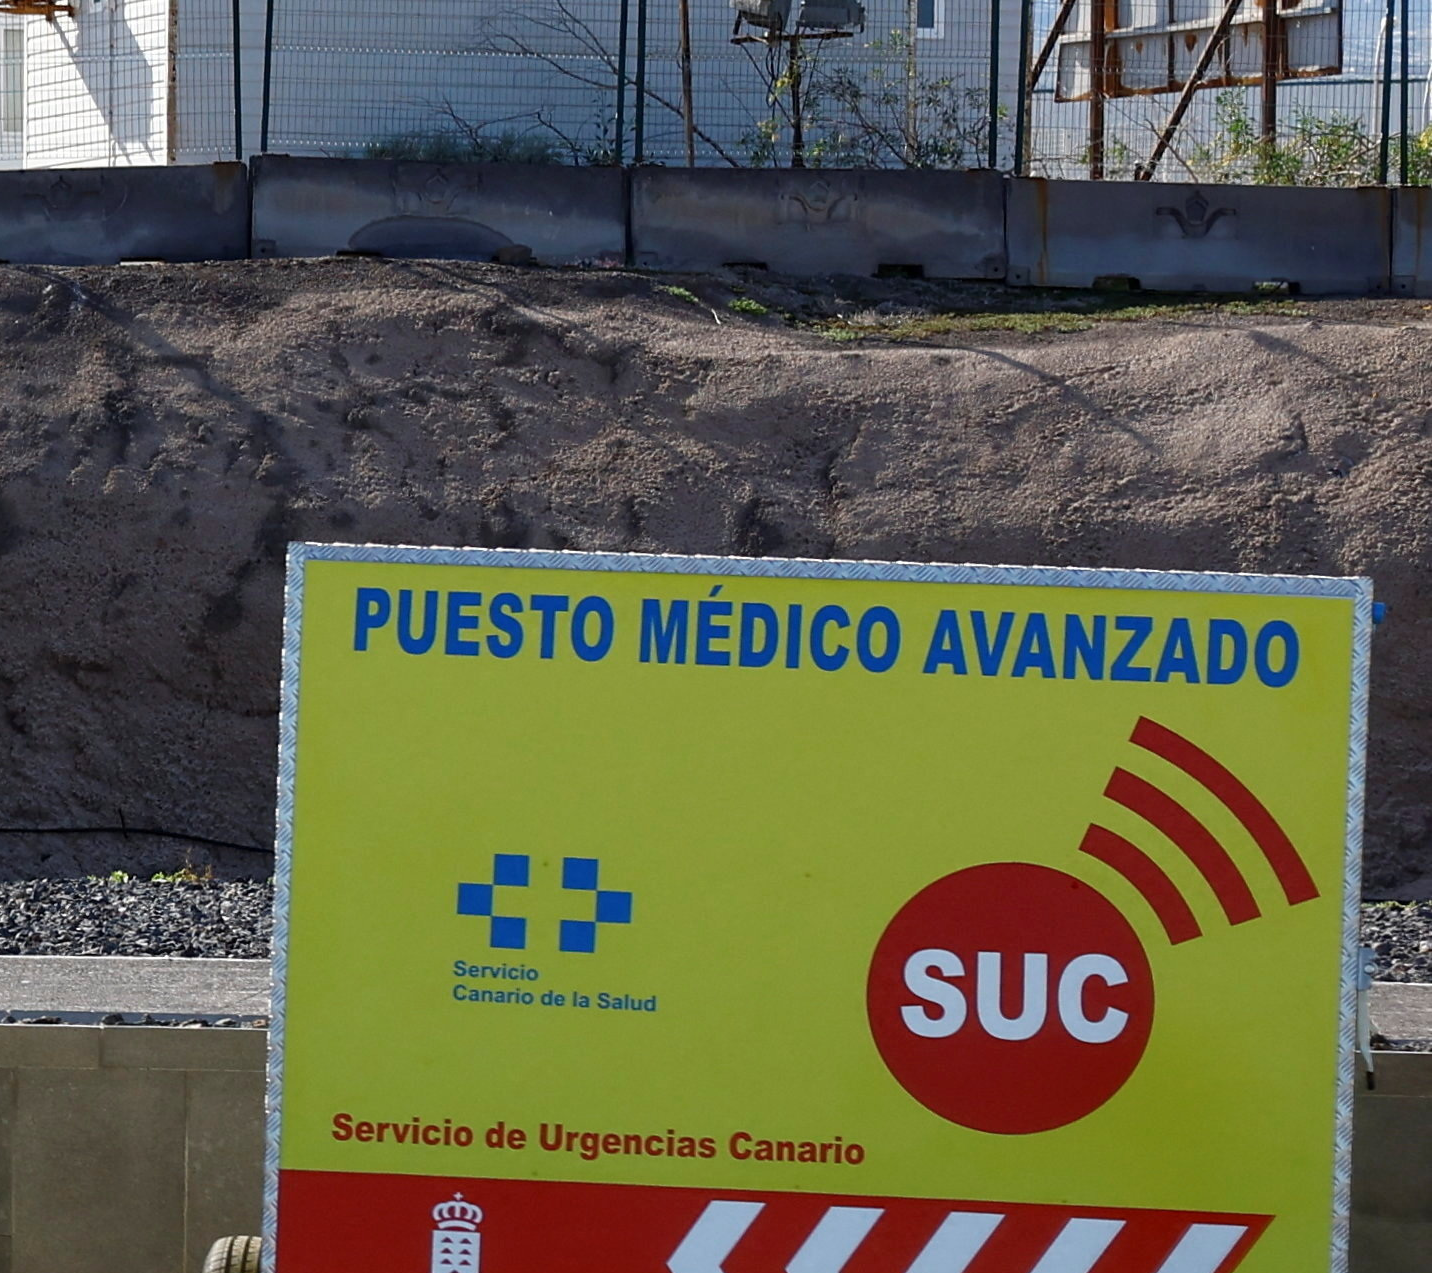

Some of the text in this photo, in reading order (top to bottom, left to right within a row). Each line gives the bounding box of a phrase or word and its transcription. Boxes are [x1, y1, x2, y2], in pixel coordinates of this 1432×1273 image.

[354, 585, 1299, 688] PUESTO MÉDICO AVANZADO
[452, 959, 539, 982] Servicio
[901, 949, 1128, 1043] SUC
[452, 984, 656, 1012] Canario de la Salud
[332, 1112, 865, 1165] Servicio de Urgencias Canario
